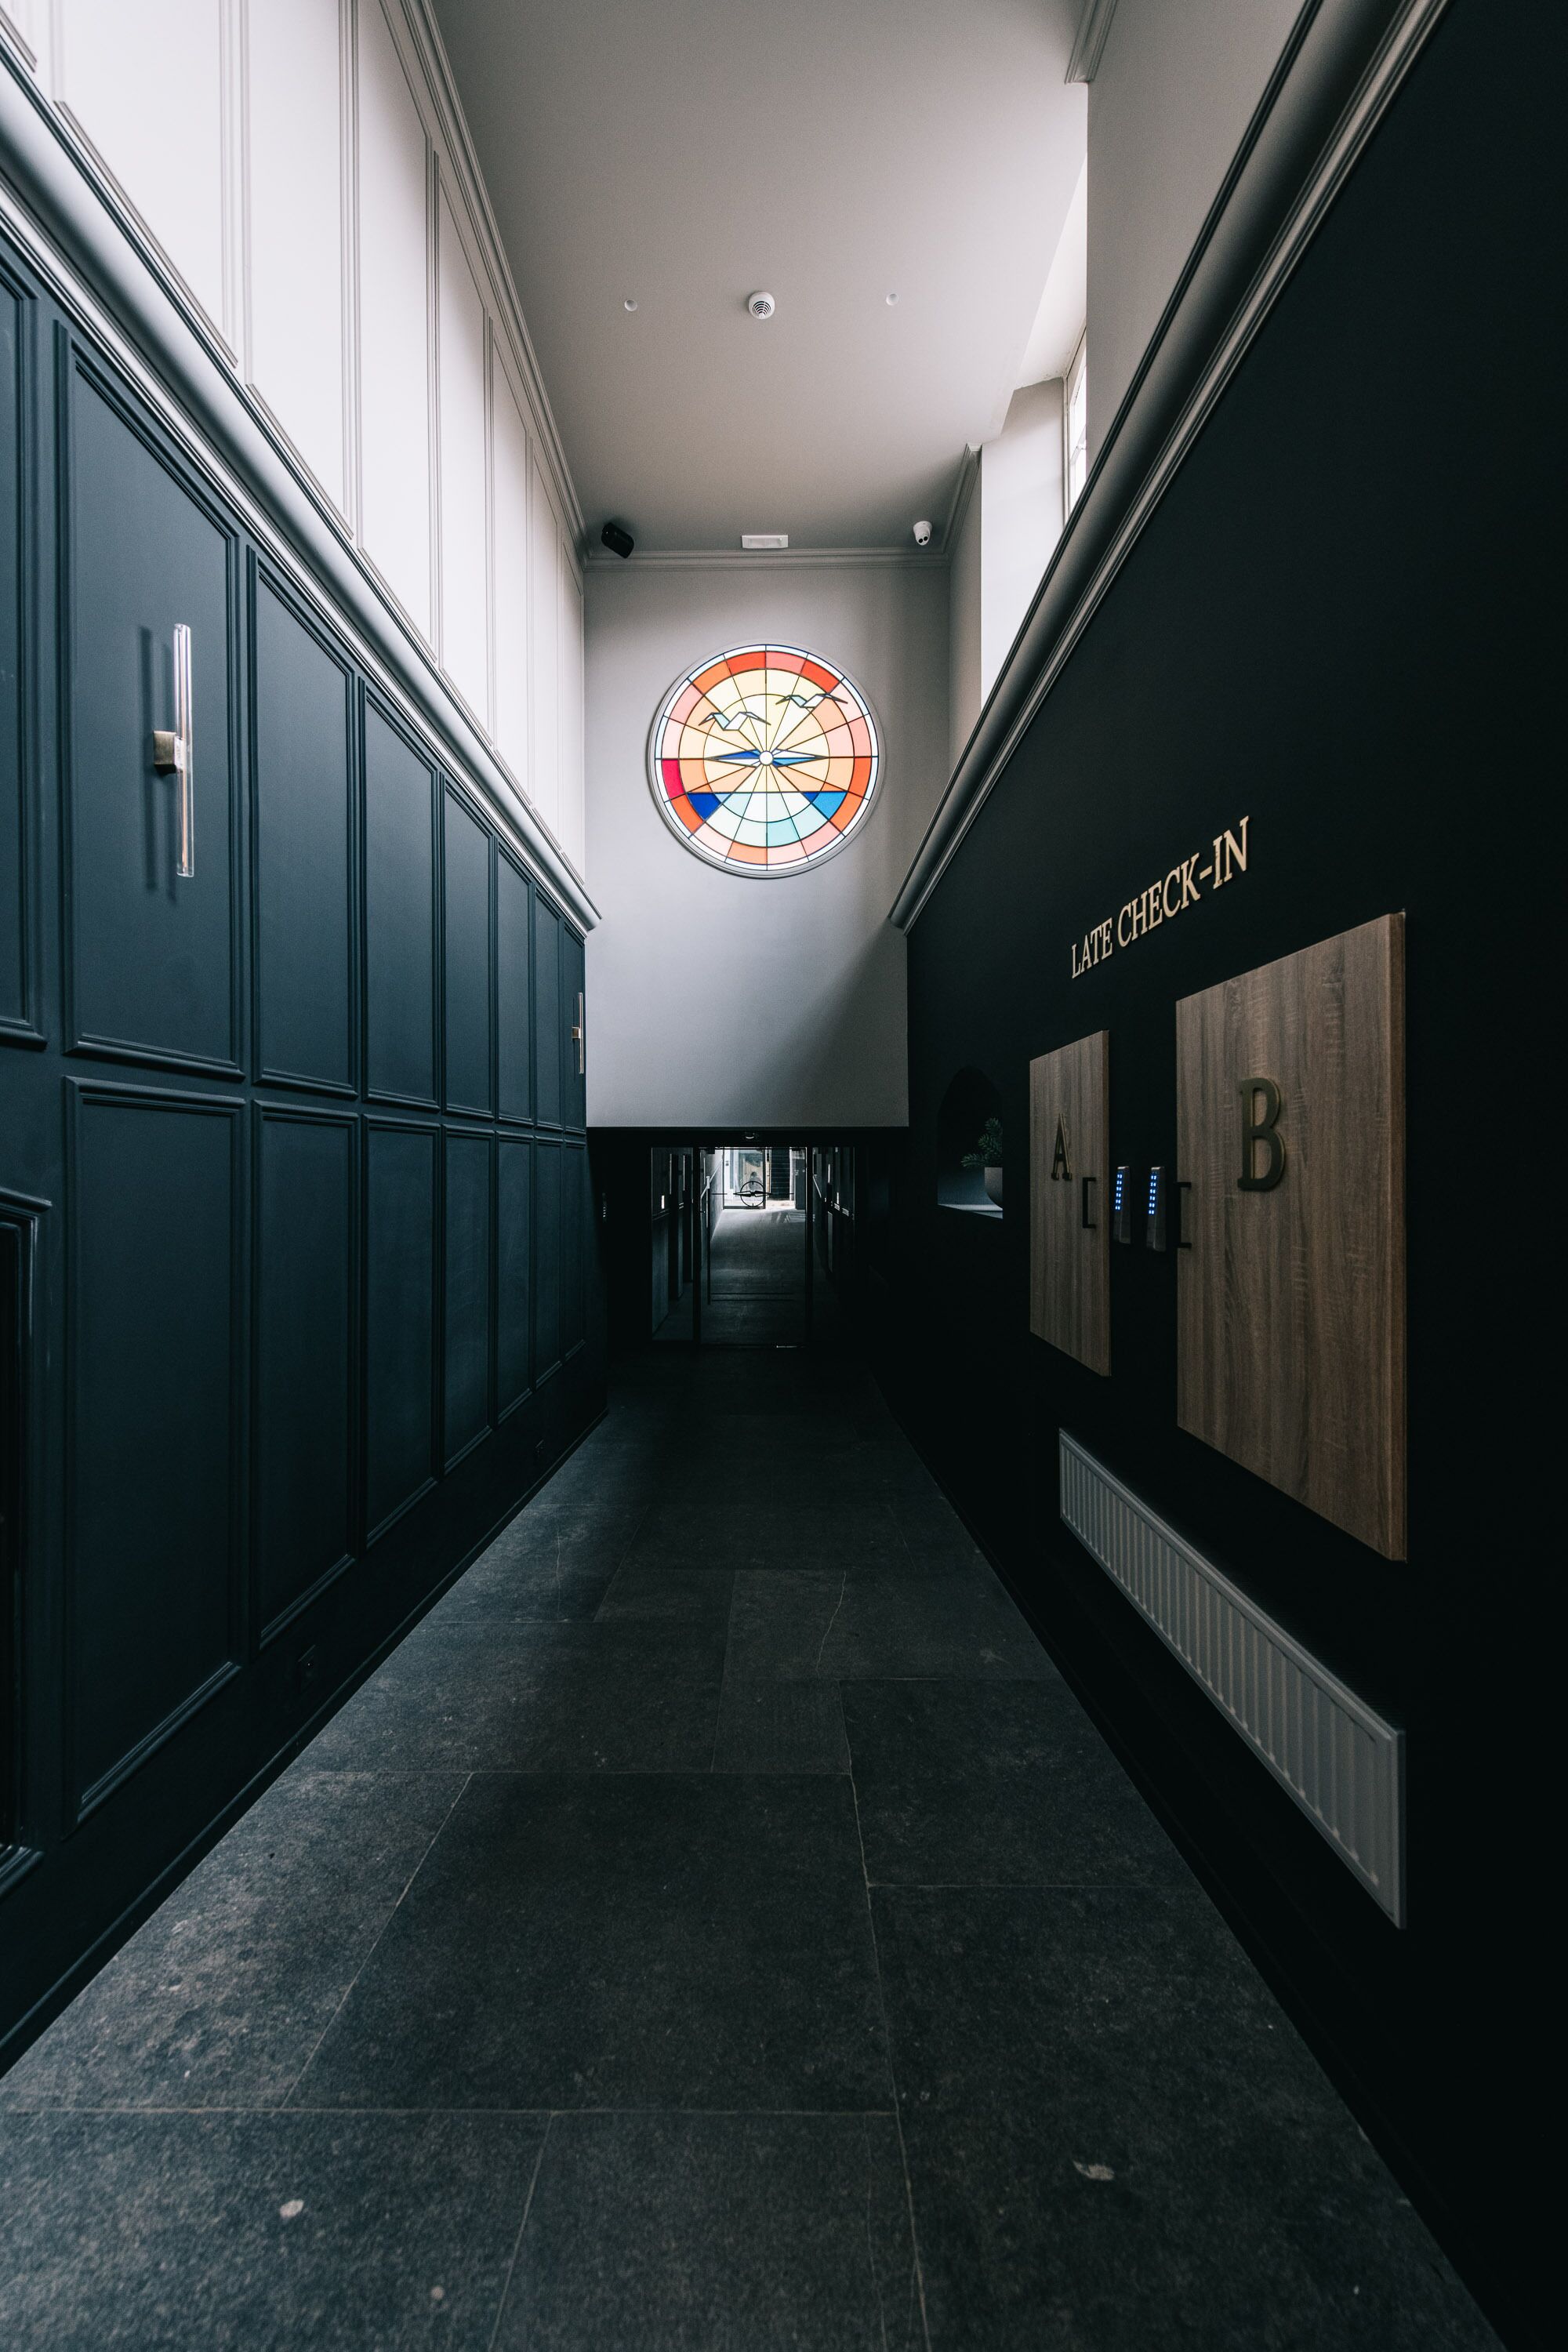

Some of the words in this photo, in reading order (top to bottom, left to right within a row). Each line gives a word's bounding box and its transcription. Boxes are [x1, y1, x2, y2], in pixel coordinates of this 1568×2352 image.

[1072, 917, 1113, 979] LATE
[1118, 815, 1250, 947] CHECK-IN
[1051, 1112, 1073, 1181] A
[1237, 1077, 1286, 1192] B
